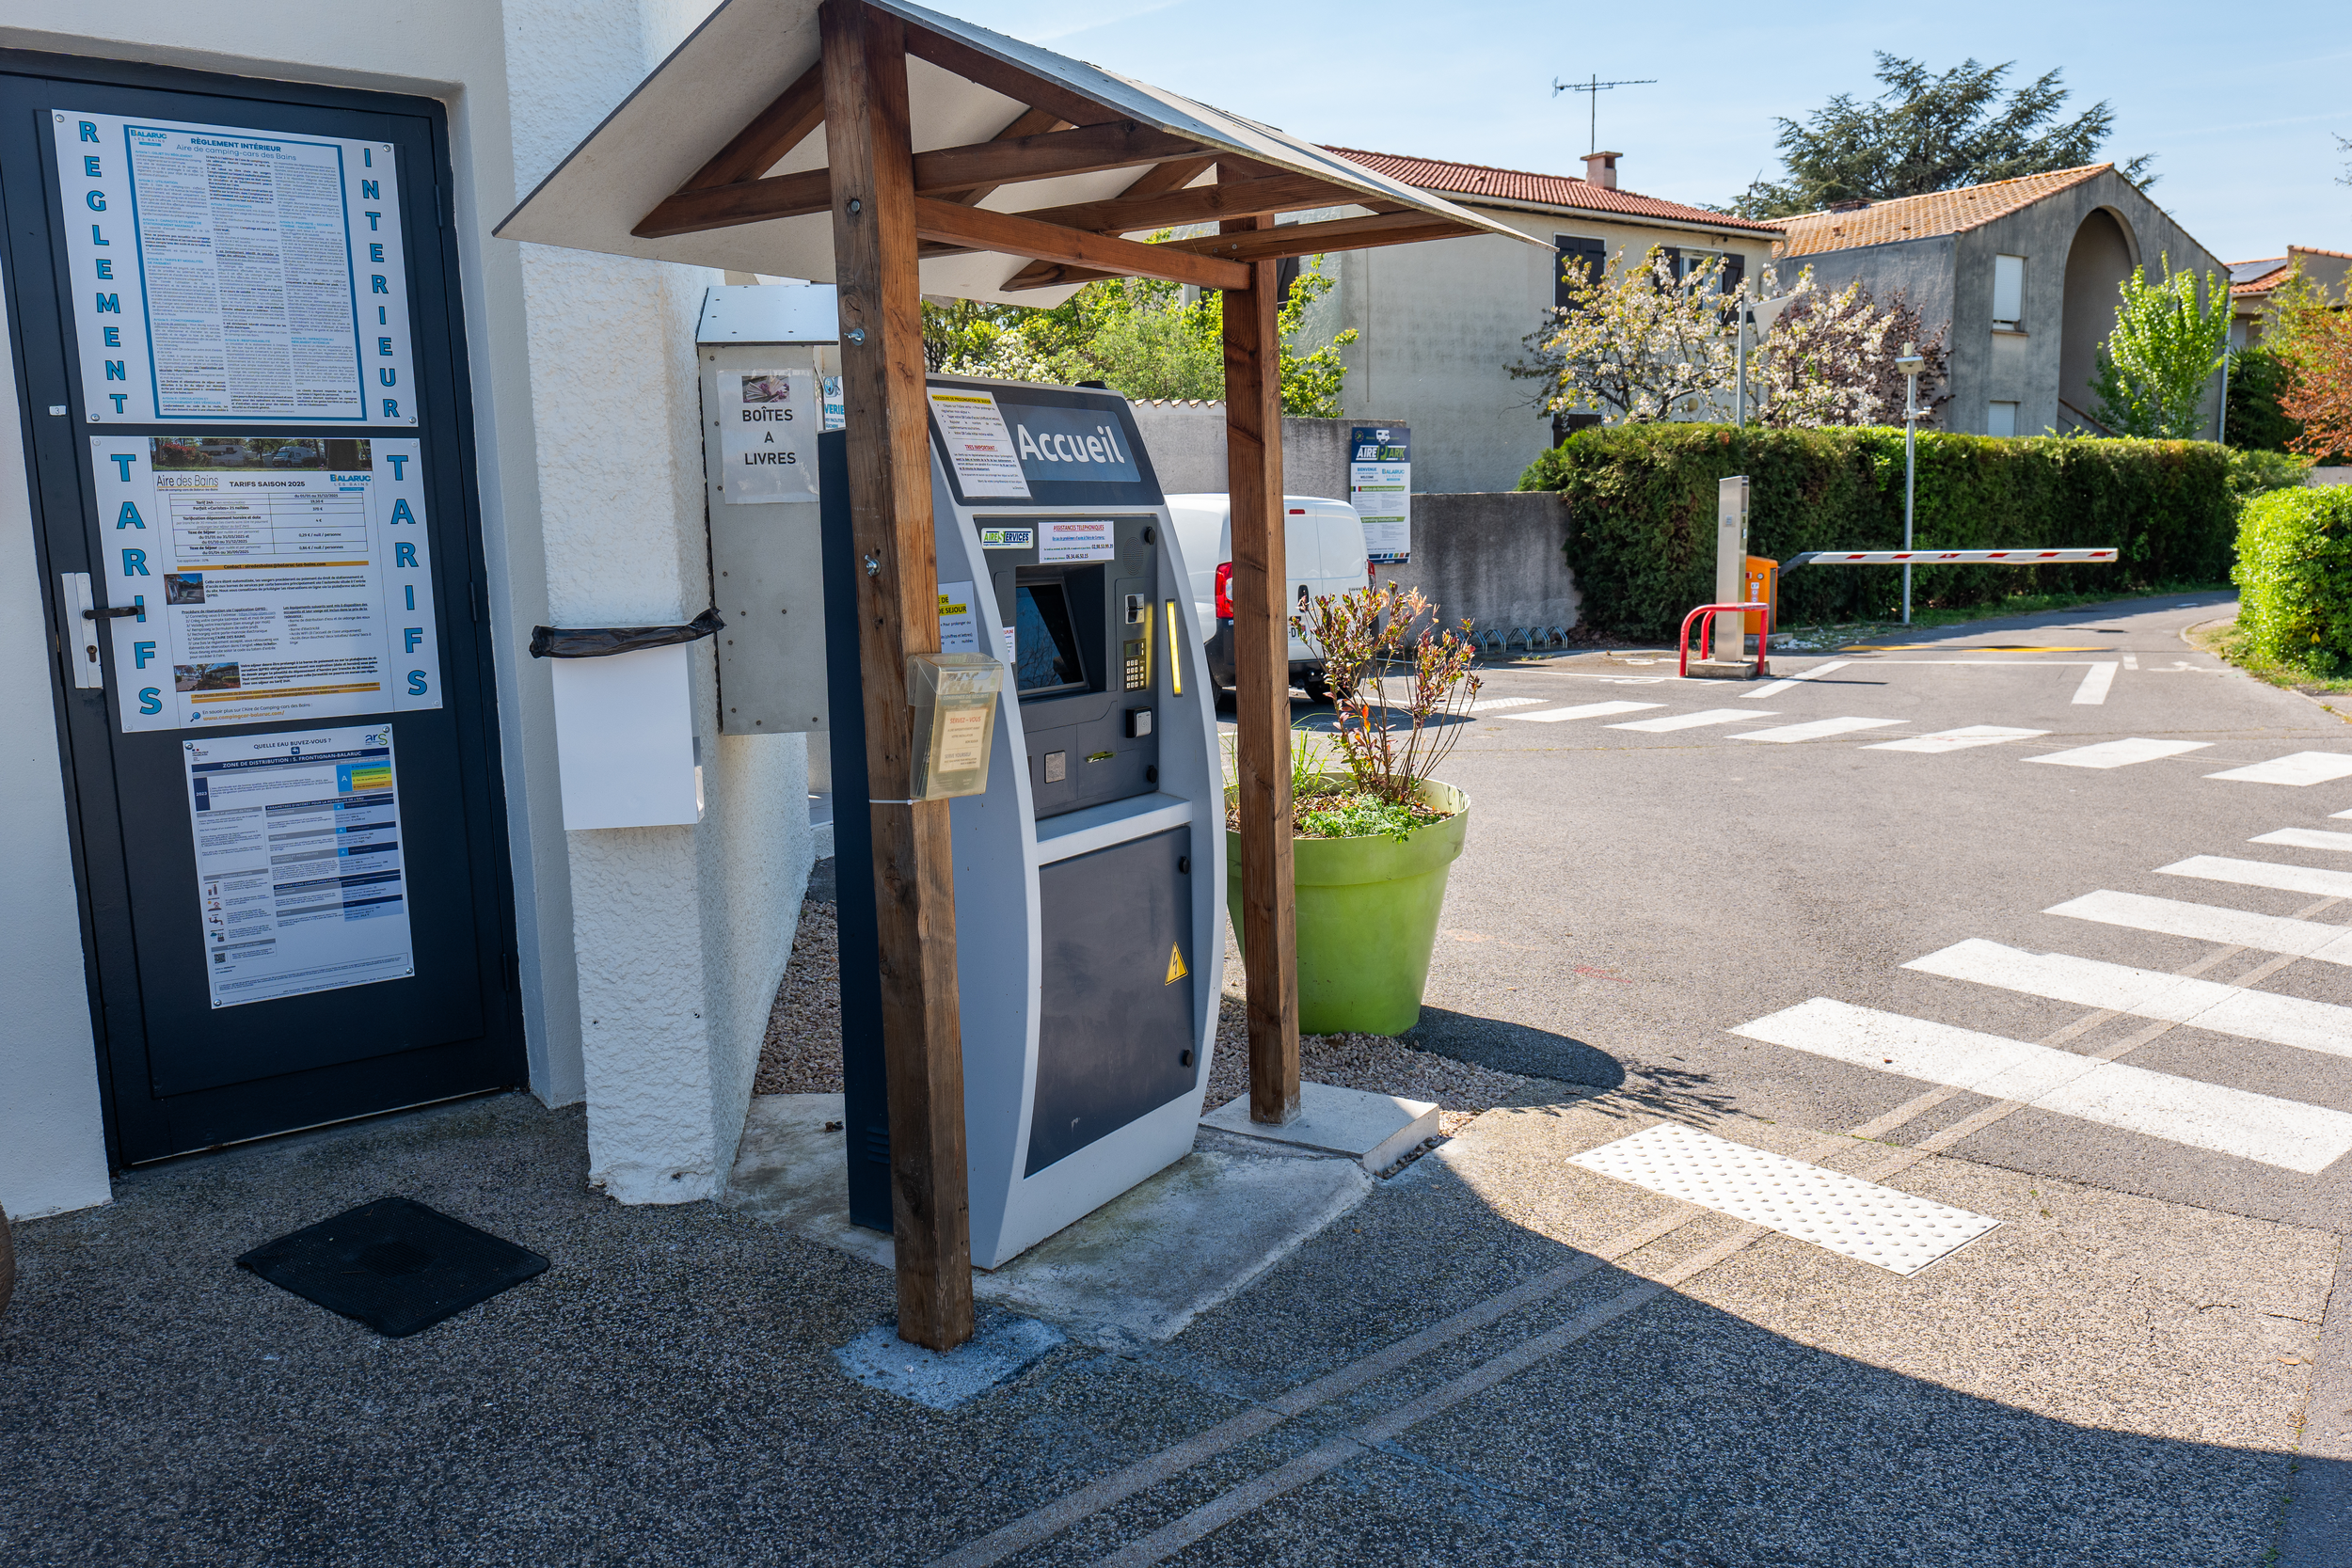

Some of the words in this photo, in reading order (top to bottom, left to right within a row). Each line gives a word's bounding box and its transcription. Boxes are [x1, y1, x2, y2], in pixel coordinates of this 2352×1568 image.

[130, 129, 167, 139] BALARUC
[190, 136, 238, 148] RÈGLEMENT
[240, 141, 281, 152] INTÉRIEUR
[204, 147, 261, 158] camping-cars
[78, 120, 128, 415] REGLEMENT
[360, 148, 400, 419] INTERIEUR
[742, 405, 793, 421] BOÎTES
[764, 431, 774, 443] A
[1017, 423, 1124, 464] Accueil
[745, 452, 796, 465] LIVRES
[155, 474, 174, 486] Aire
[175, 473, 193, 486] des
[193, 474, 219, 486] Bains
[329, 473, 371, 482] BALARUC
[387, 454, 429, 697] TARIFS
[110, 453, 162, 716] TARIFS
[248, 757, 289, 766] DISTRIBUTION
[298, 750, 361, 761] FRONTIGNAN-BALARUC
